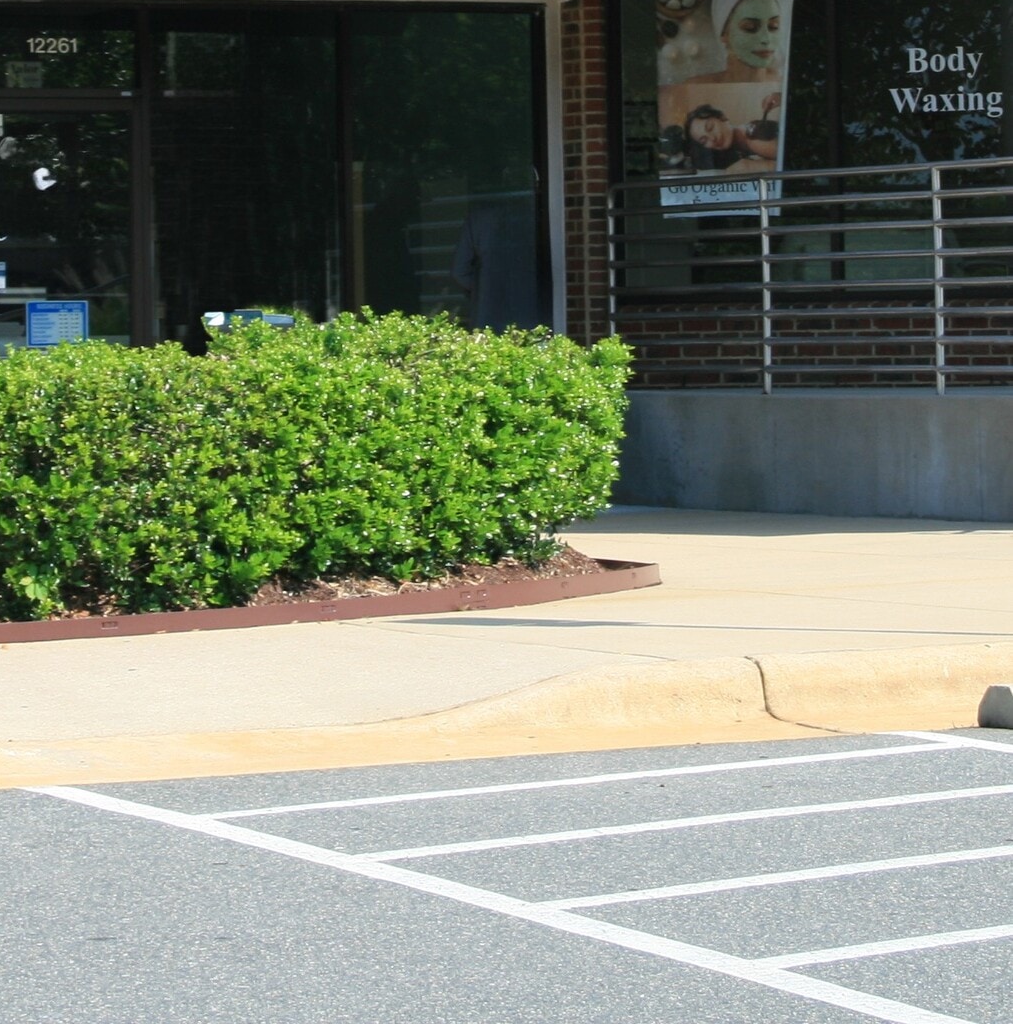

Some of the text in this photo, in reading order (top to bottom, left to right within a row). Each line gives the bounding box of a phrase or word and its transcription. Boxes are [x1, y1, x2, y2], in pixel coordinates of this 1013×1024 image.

[26, 37, 78, 54] 12261
[906, 46, 984, 79] Body
[888, 86, 1004, 118] Waxing
[691, 181, 748, 196] Organic
